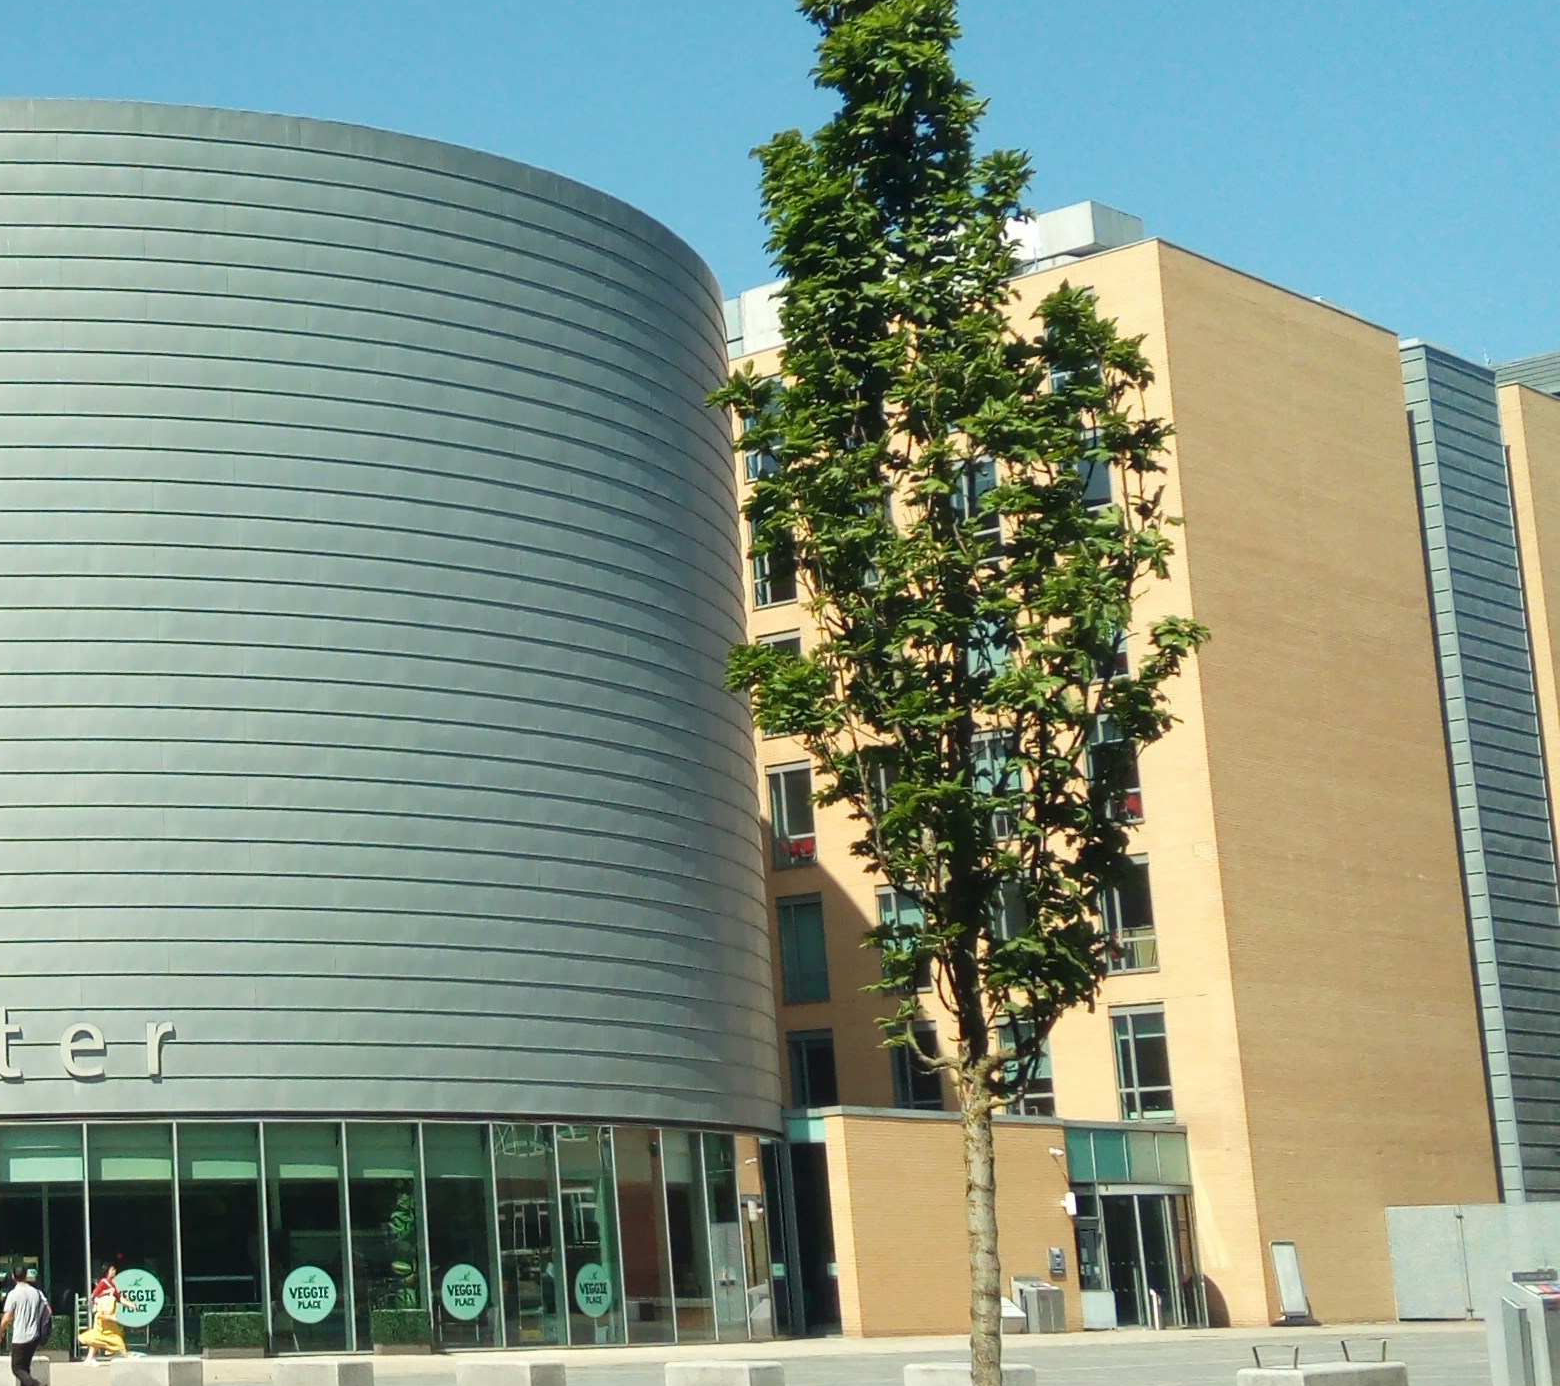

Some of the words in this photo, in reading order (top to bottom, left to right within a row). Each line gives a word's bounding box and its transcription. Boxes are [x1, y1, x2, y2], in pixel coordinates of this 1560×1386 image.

[289, 1286, 329, 1299] VEGGIE
[447, 1284, 482, 1296] VEGGIE
[579, 1282, 607, 1294] VEGGIE
[120, 1289, 156, 1302] EGGIE
[454, 1297, 475, 1306] PLACE
[298, 1300, 321, 1309] PLACE
